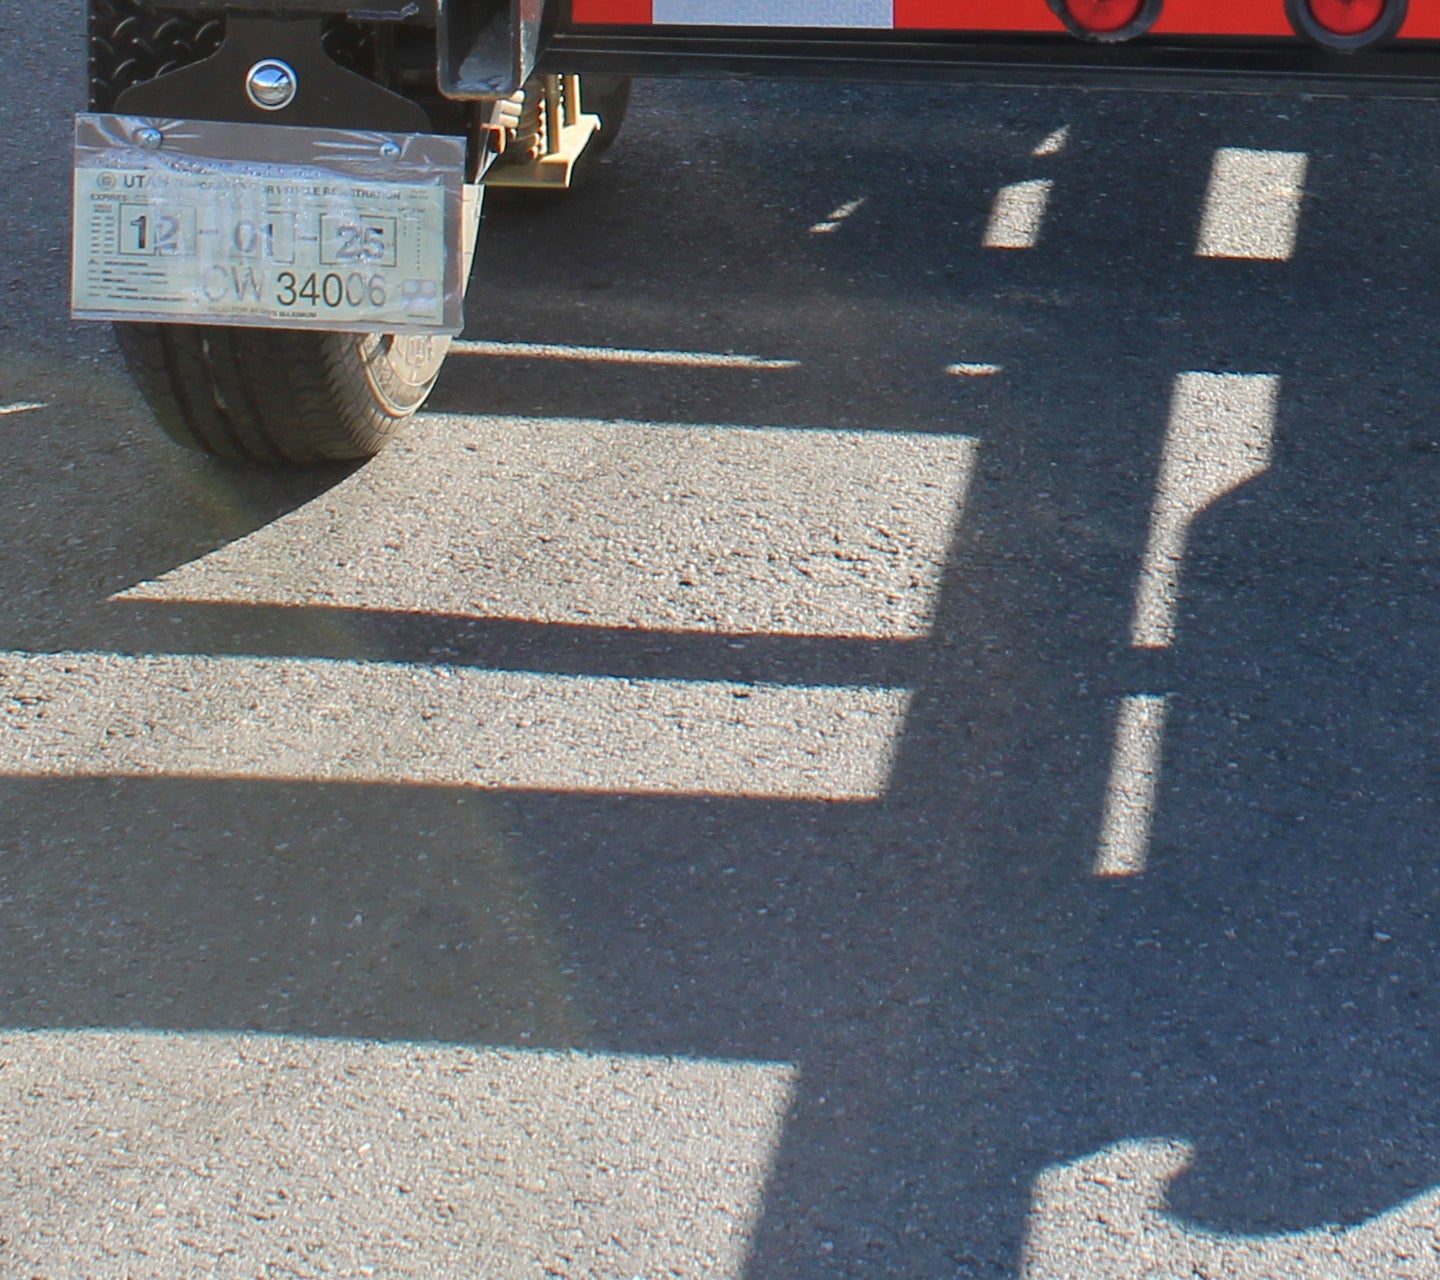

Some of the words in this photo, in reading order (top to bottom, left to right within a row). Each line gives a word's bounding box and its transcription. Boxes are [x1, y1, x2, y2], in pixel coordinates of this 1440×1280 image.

[129, 215, 180, 253] 12
[234, 218, 274, 258] 01
[335, 225, 386, 260] 25
[276, 271, 387, 308] 34006
